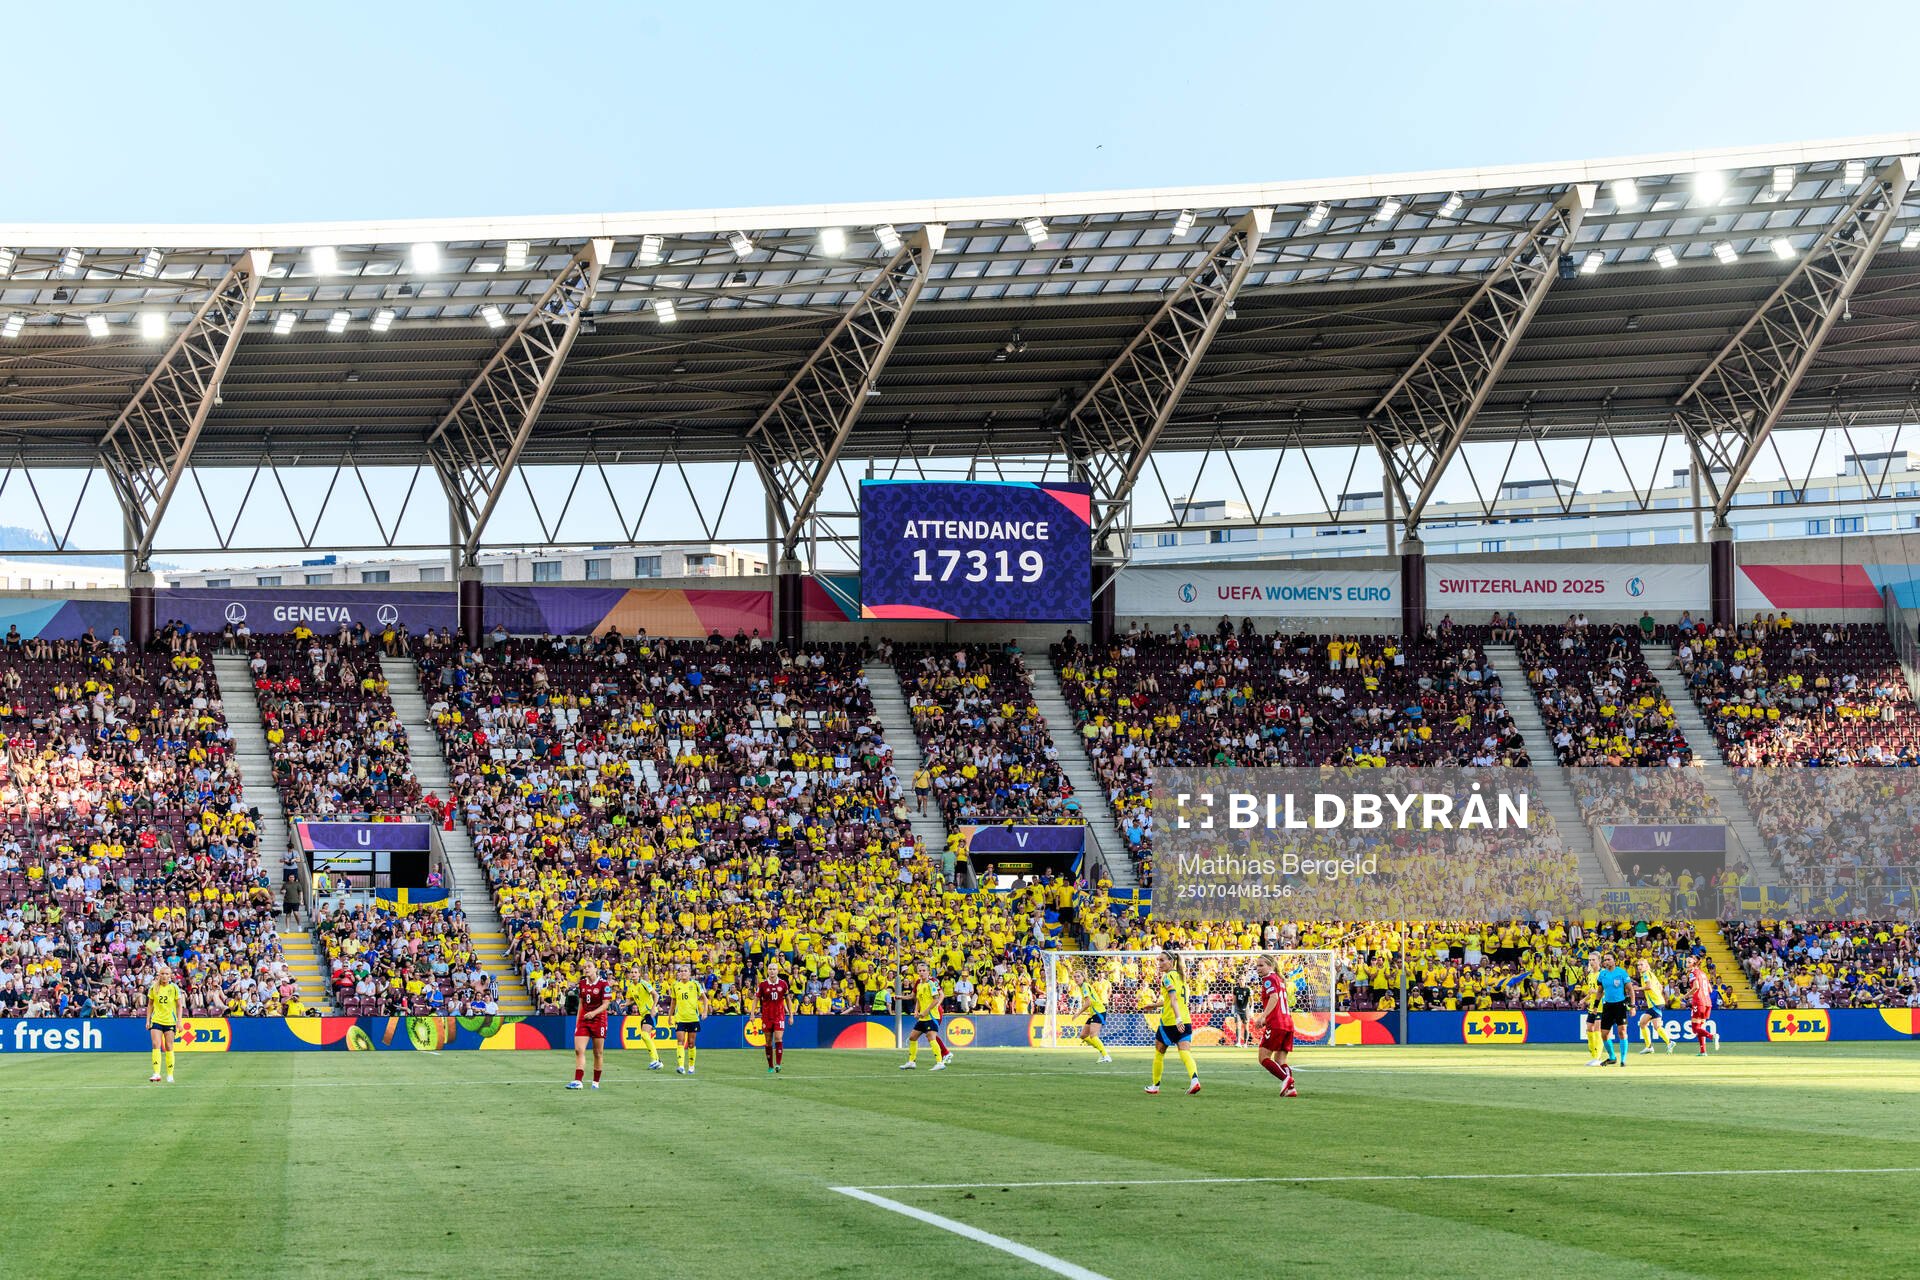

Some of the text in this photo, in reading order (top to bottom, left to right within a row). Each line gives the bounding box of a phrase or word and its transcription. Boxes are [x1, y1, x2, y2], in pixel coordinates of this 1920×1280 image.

[904, 520, 1049, 540] ATTENDANCE
[913, 549, 1044, 582] 17319
[1218, 586, 1391, 600] UEFA WOMEN'S EURO
[1439, 579, 1605, 593] SWITZERLAND 2025
[274, 606, 351, 622] GENEVA
[357, 830, 371, 845] U
[1016, 832, 1028, 847] V
[1654, 831, 1671, 846] W
[159, 995, 168, 1004] 22
[586, 994, 591, 1004] 8
[681, 992, 689, 1001] 16
[771, 991, 778, 1001] 10
[14, 1020, 102, 1050] fresh
[600, 1026, 605, 1037] 8
